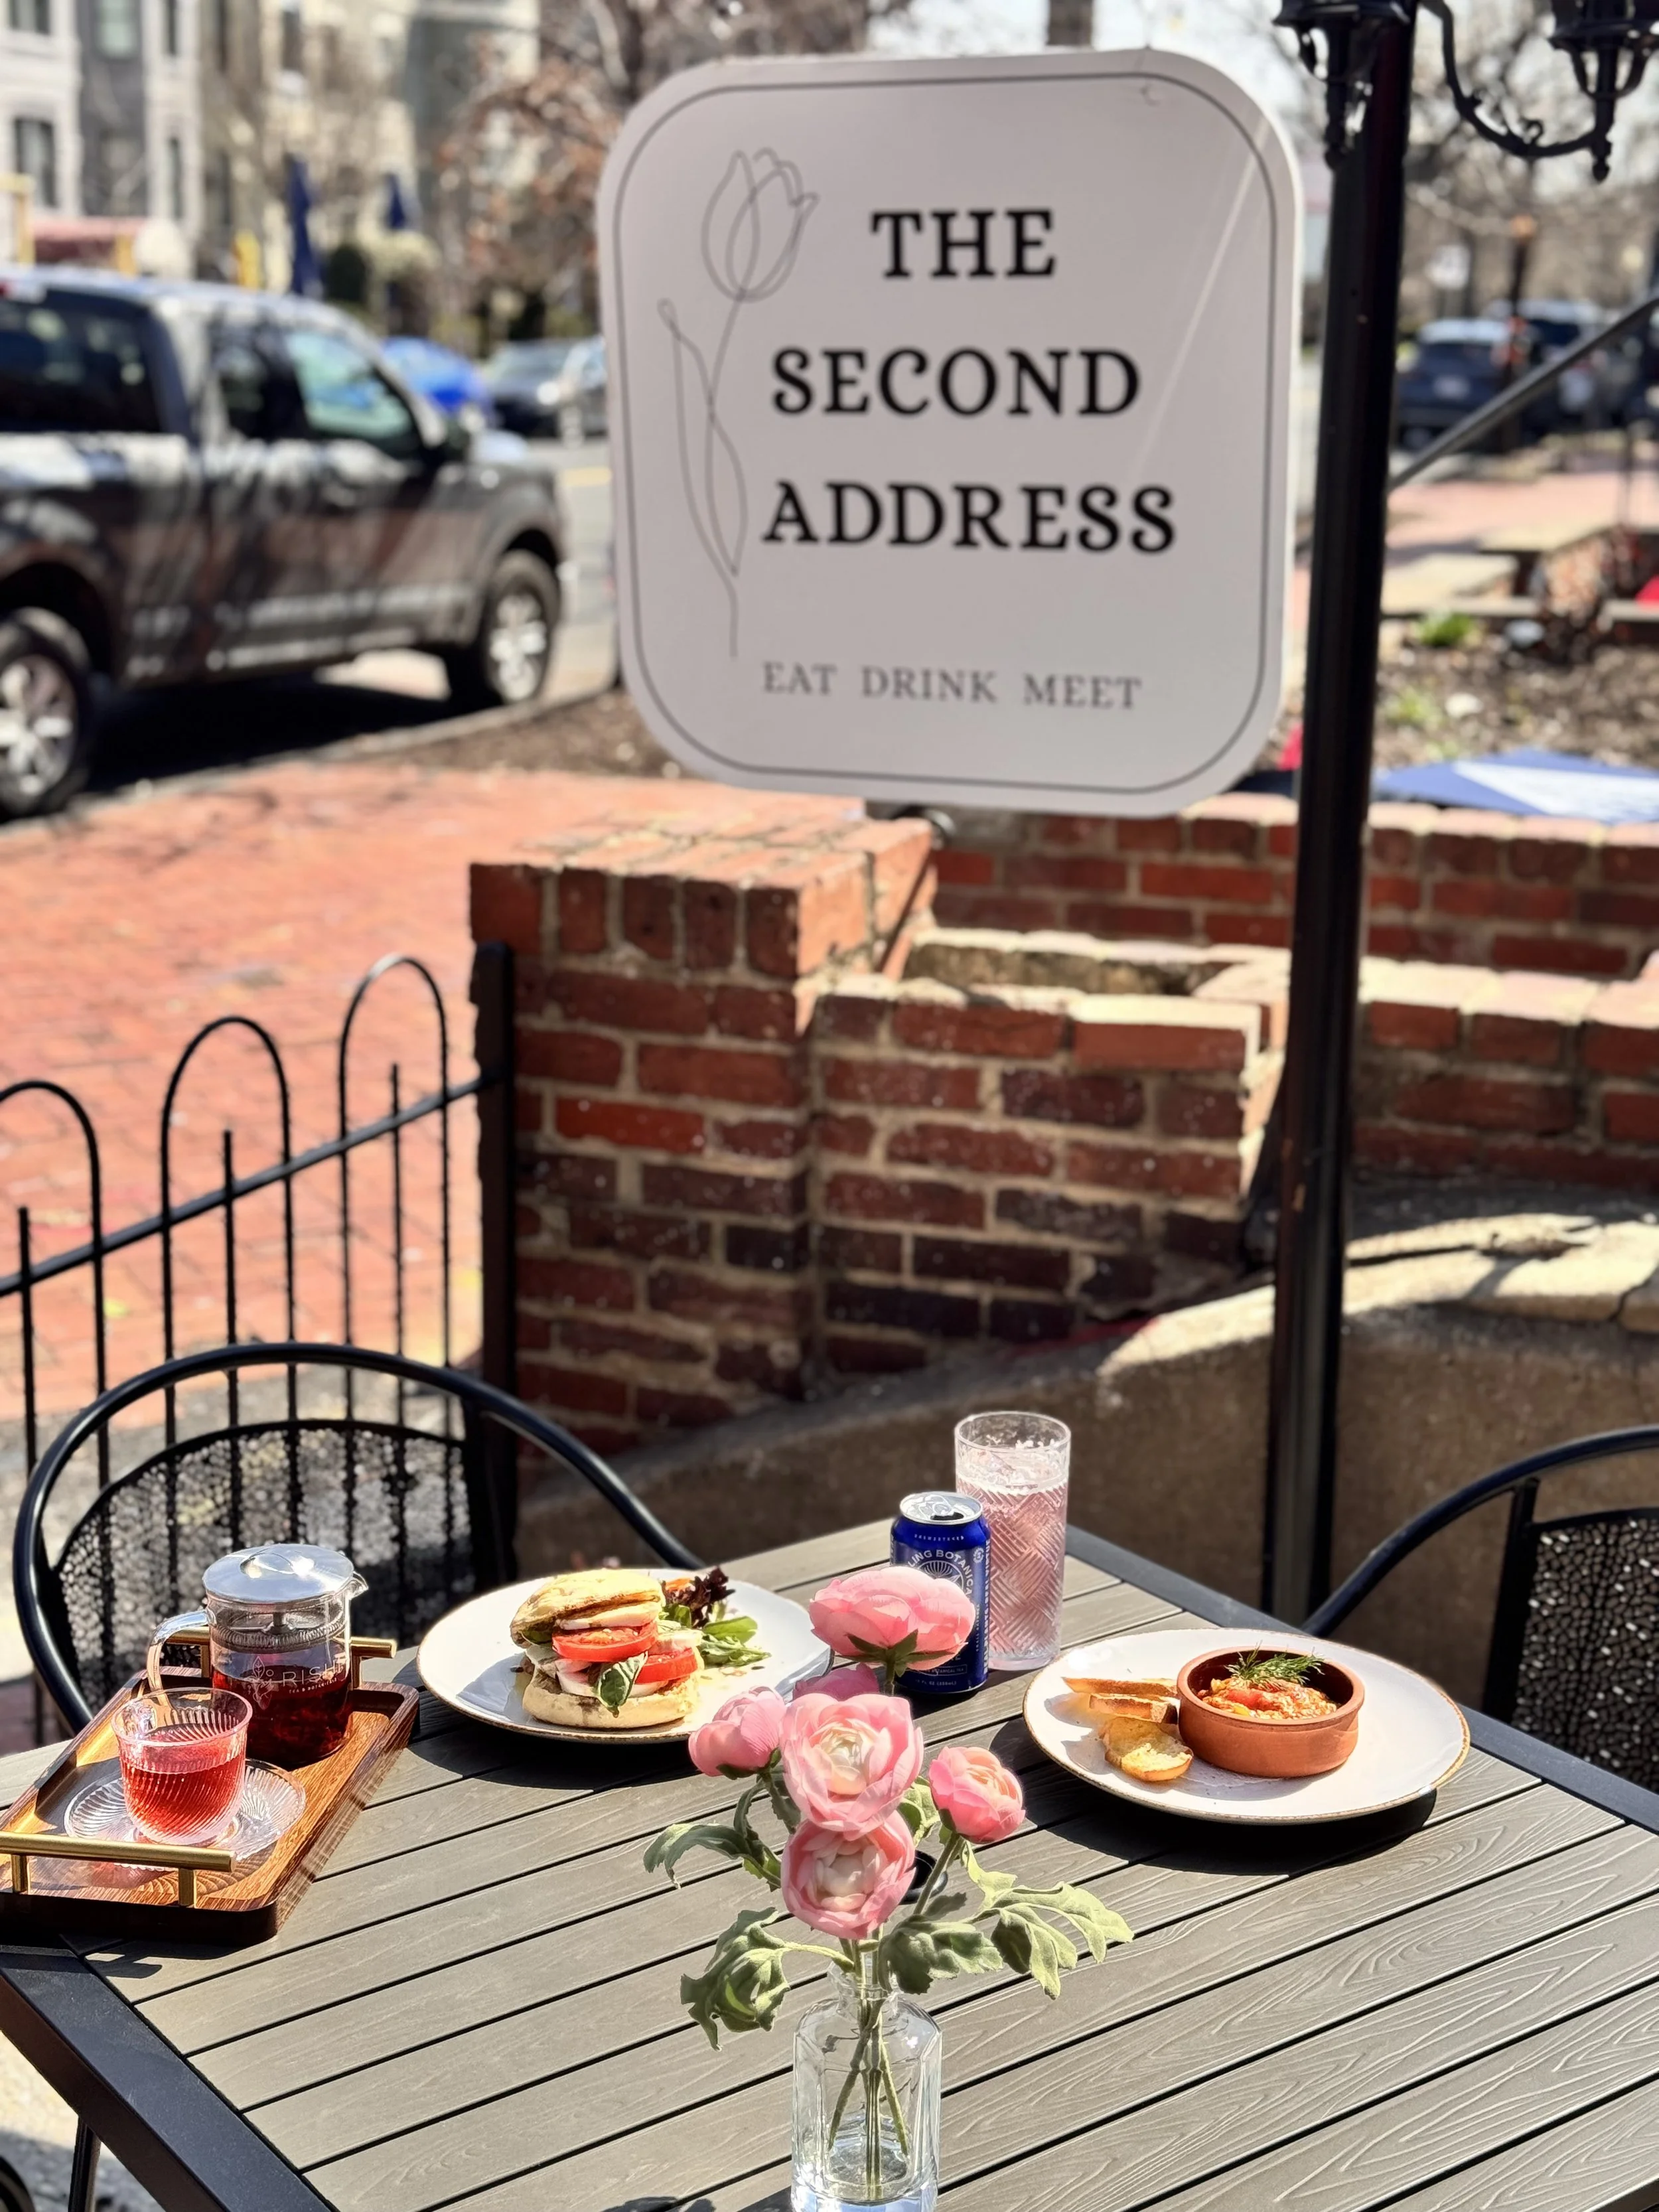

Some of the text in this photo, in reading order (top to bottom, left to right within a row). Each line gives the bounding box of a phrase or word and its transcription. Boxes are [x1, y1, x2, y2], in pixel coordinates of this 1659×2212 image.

[871, 208, 1056, 278] THE
[772, 347, 1140, 417] SECOND
[761, 479, 1175, 554] ADDRESS
[762, 661, 1141, 709] EAT DRINK MEET
[936, 1549, 974, 1595] BOTANICA
